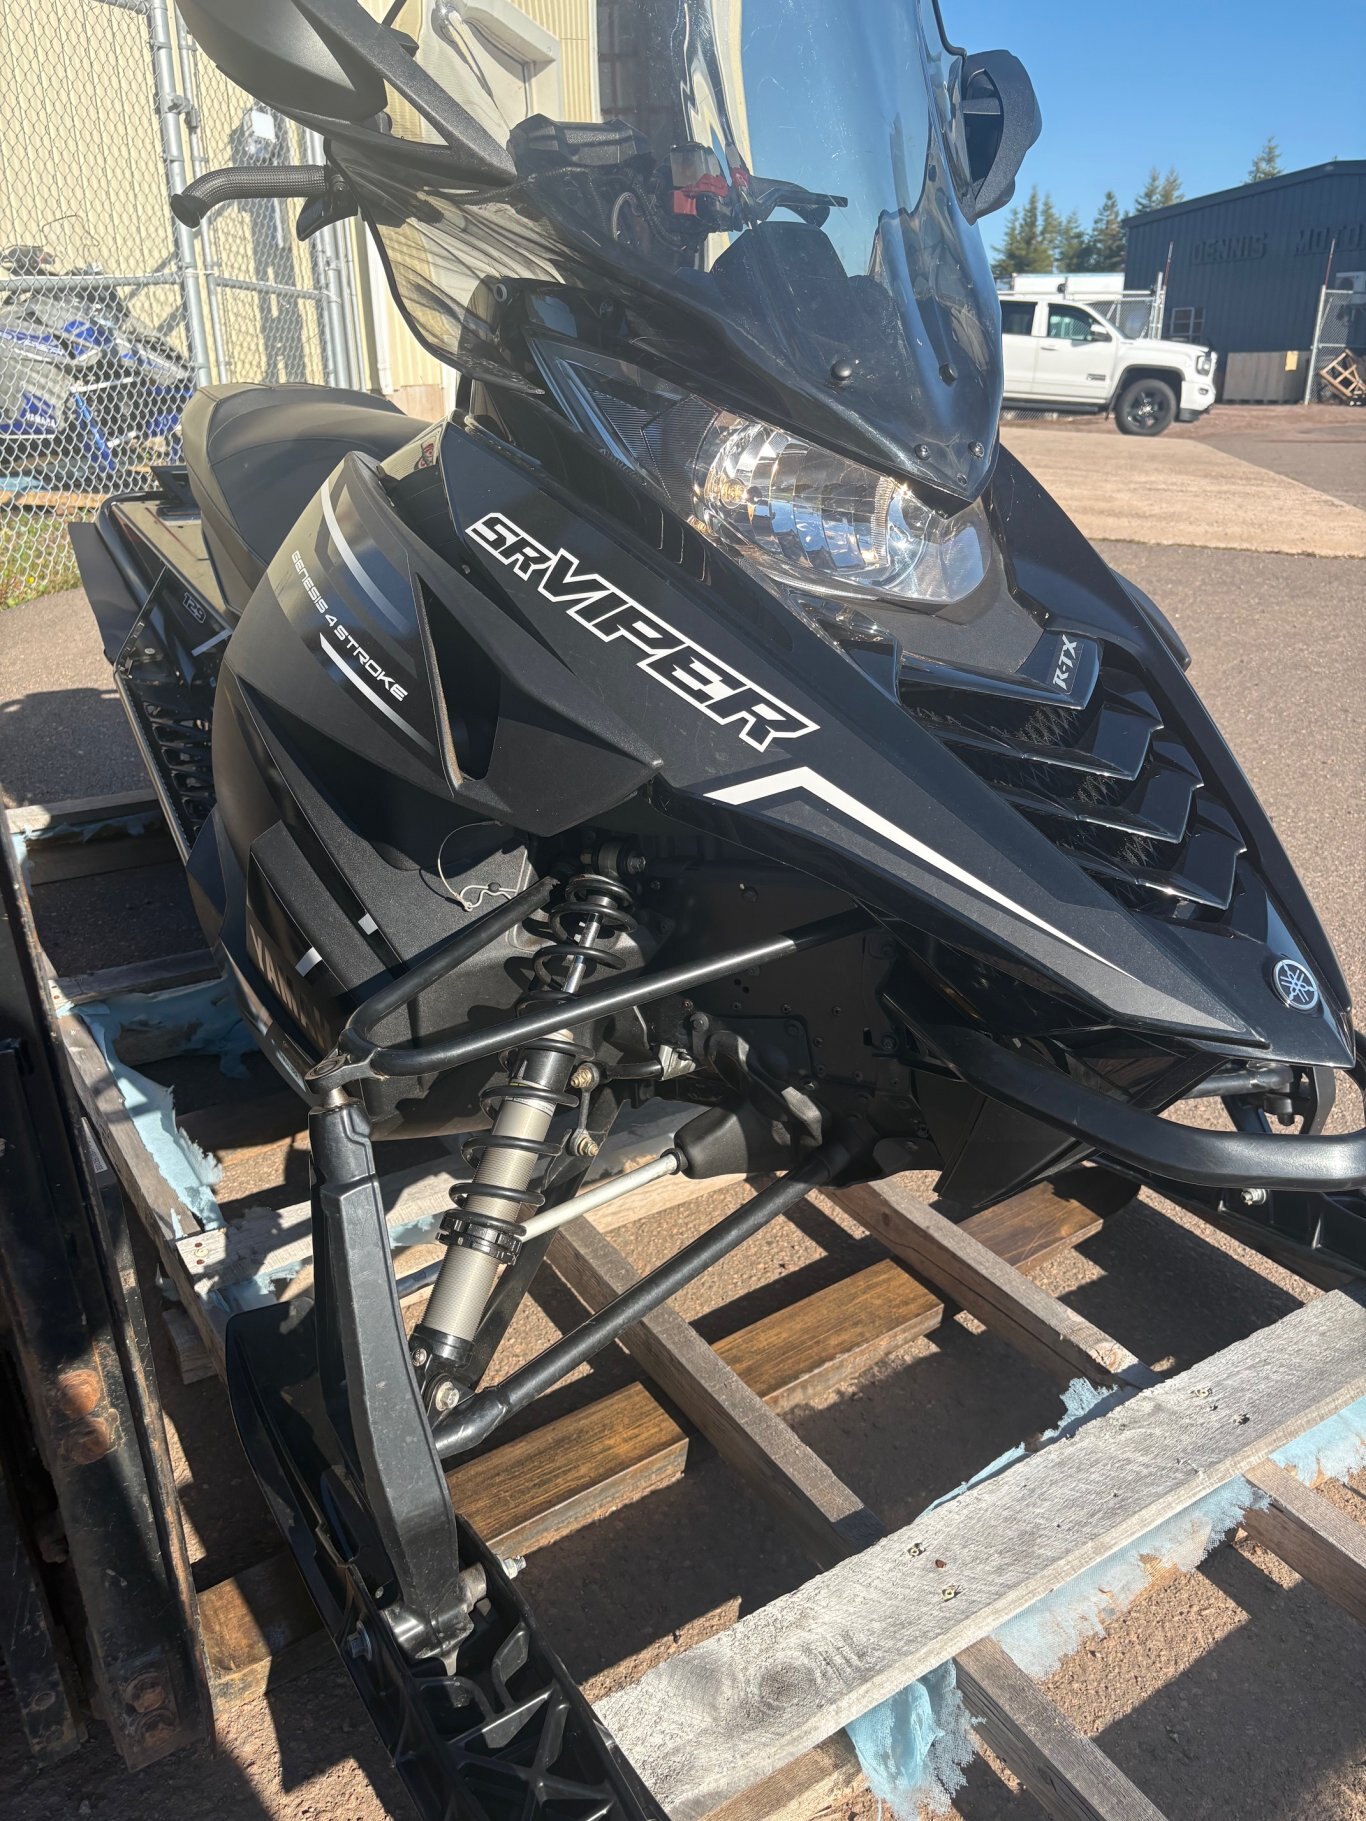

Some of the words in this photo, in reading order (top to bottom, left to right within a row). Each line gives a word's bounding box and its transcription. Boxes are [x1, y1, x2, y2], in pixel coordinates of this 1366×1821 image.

[183, 592, 207, 624] 129
[291, 550, 329, 614] GENESIS
[325, 614, 338, 627] 4
[333, 625, 409, 702] STROKE
[1052, 634, 1077, 690] R-TX
